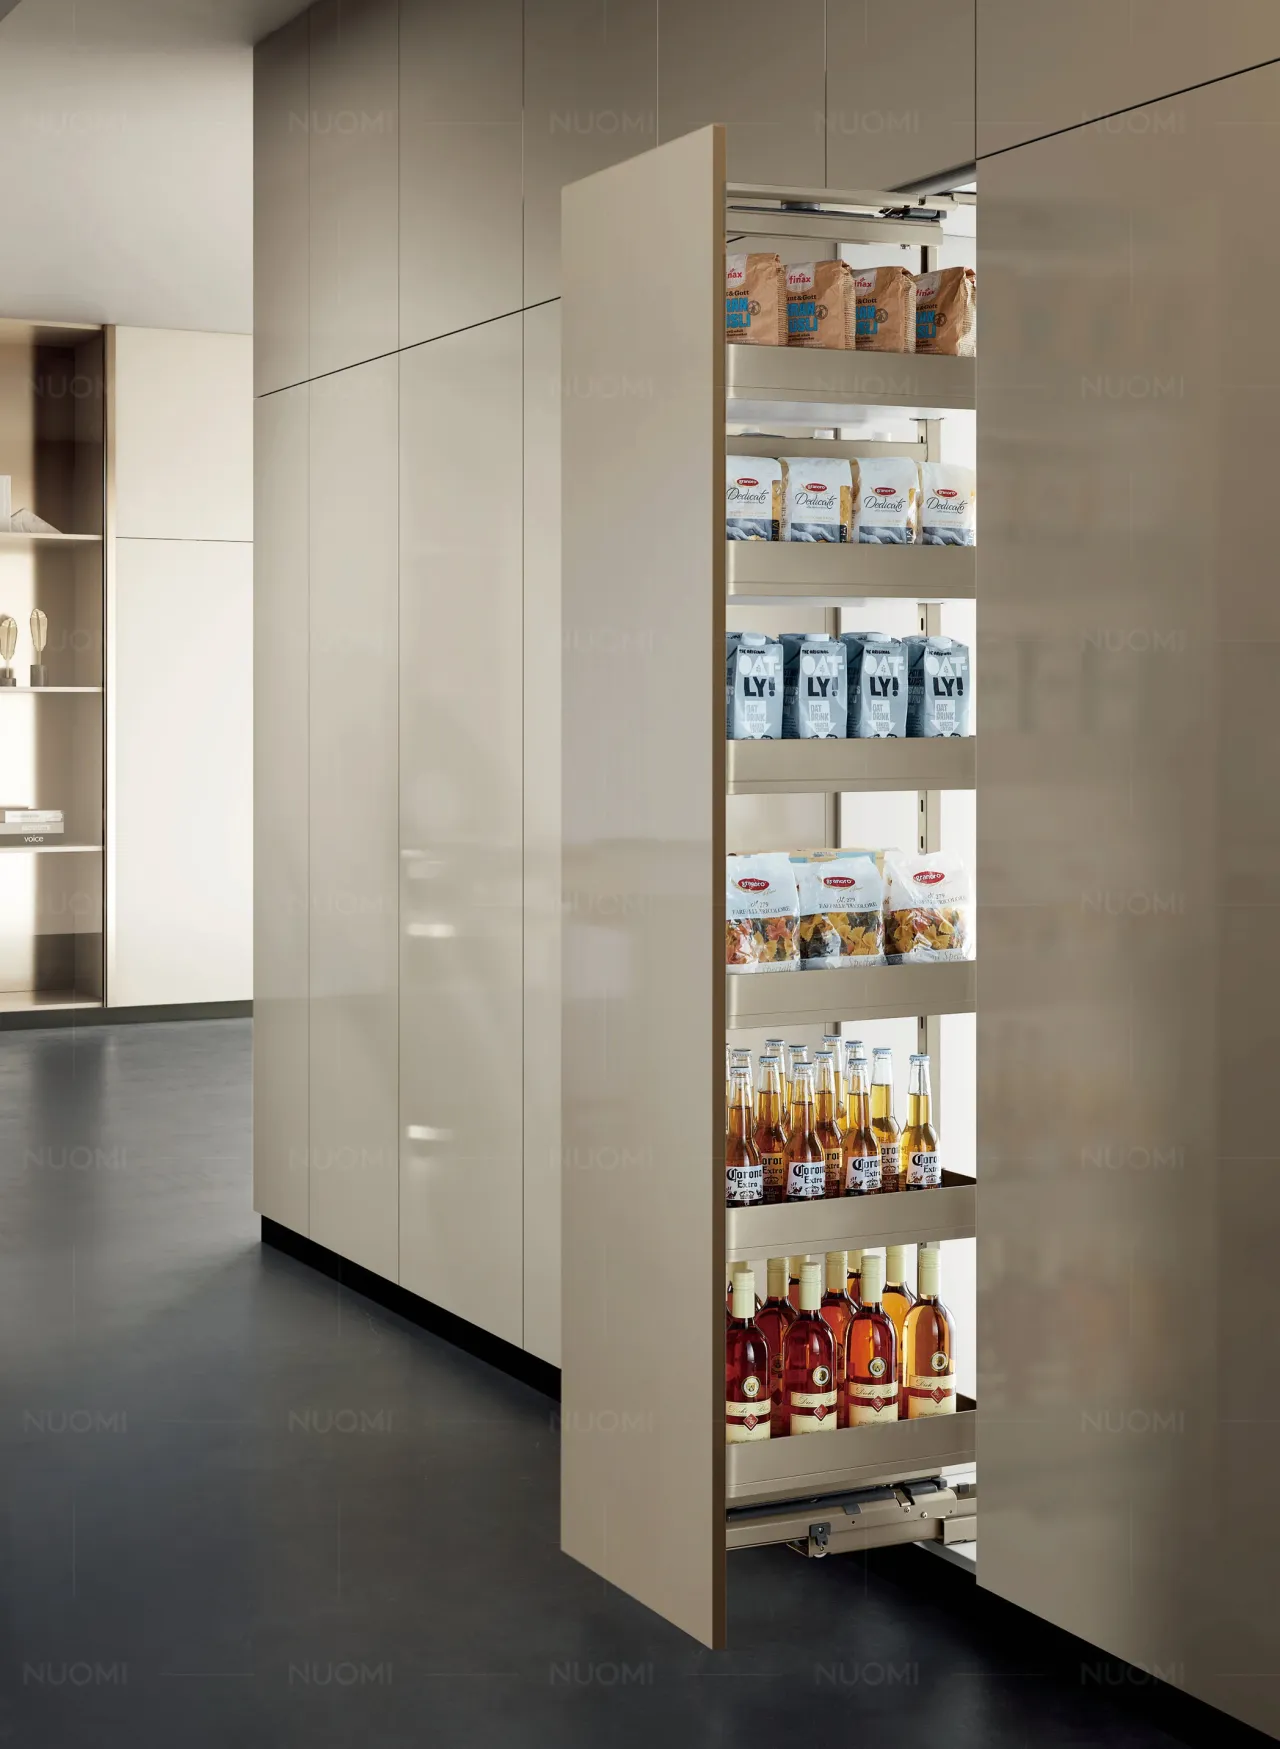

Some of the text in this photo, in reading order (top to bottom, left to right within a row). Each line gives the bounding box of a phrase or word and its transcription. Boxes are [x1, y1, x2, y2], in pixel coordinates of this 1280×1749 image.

[789, 275, 811, 284] finax
[744, 677, 775, 697] LY!
[808, 677, 838, 697] LY!
[870, 676, 898, 697] LY!
[933, 677, 963, 696] LY!
[873, 704, 883, 712] OAT
[811, 713, 829, 721] DRINK
[873, 712, 889, 720] DRINK
[24, 835, 44, 843] voice
[738, 1180, 758, 1188] Extra
